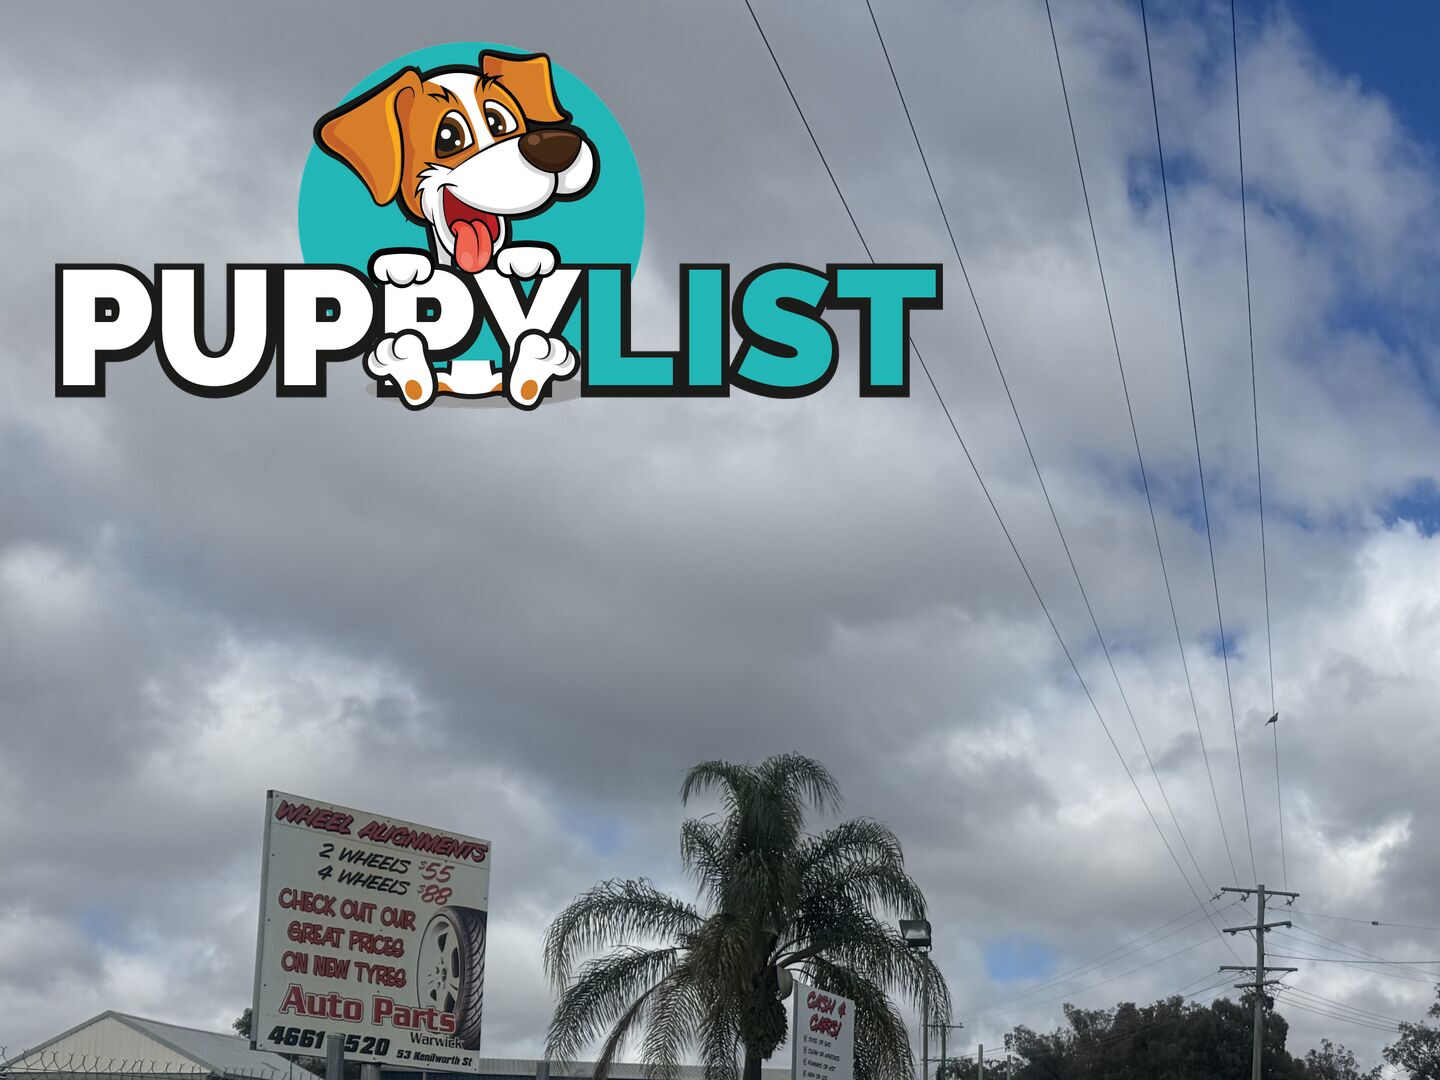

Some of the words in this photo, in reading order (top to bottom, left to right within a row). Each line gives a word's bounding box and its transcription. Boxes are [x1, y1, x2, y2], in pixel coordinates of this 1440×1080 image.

[275, 799, 354, 835] WHEEL
[357, 820, 488, 863] ALIGNMENTS
[319, 843, 335, 859] 2
[338, 847, 412, 874] WHEELS
[417, 861, 455, 883] $55
[317, 865, 333, 880] 4
[337, 868, 411, 896] WHEELS
[416, 884, 453, 906] $88
[278, 887, 336, 917] CHECK
[340, 901, 378, 924] OUT
[380, 906, 416, 932] OUR
[287, 920, 345, 945] GREAT
[349, 930, 405, 958] PRICES
[280, 950, 308, 974] ON
[312, 957, 351, 980] NEW
[354, 962, 407, 989] TYRES
[279, 983, 364, 1022] Auto
[371, 994, 458, 1034] Parts
[267, 1025, 326, 1050] 4661
[334, 1032, 391, 1057] 520
[396, 1049, 412, 1060] 53
[413, 1051, 461, 1066] Kenilworth
[461, 1057, 473, 1067] St
[410, 1032, 463, 1050] Warwick
